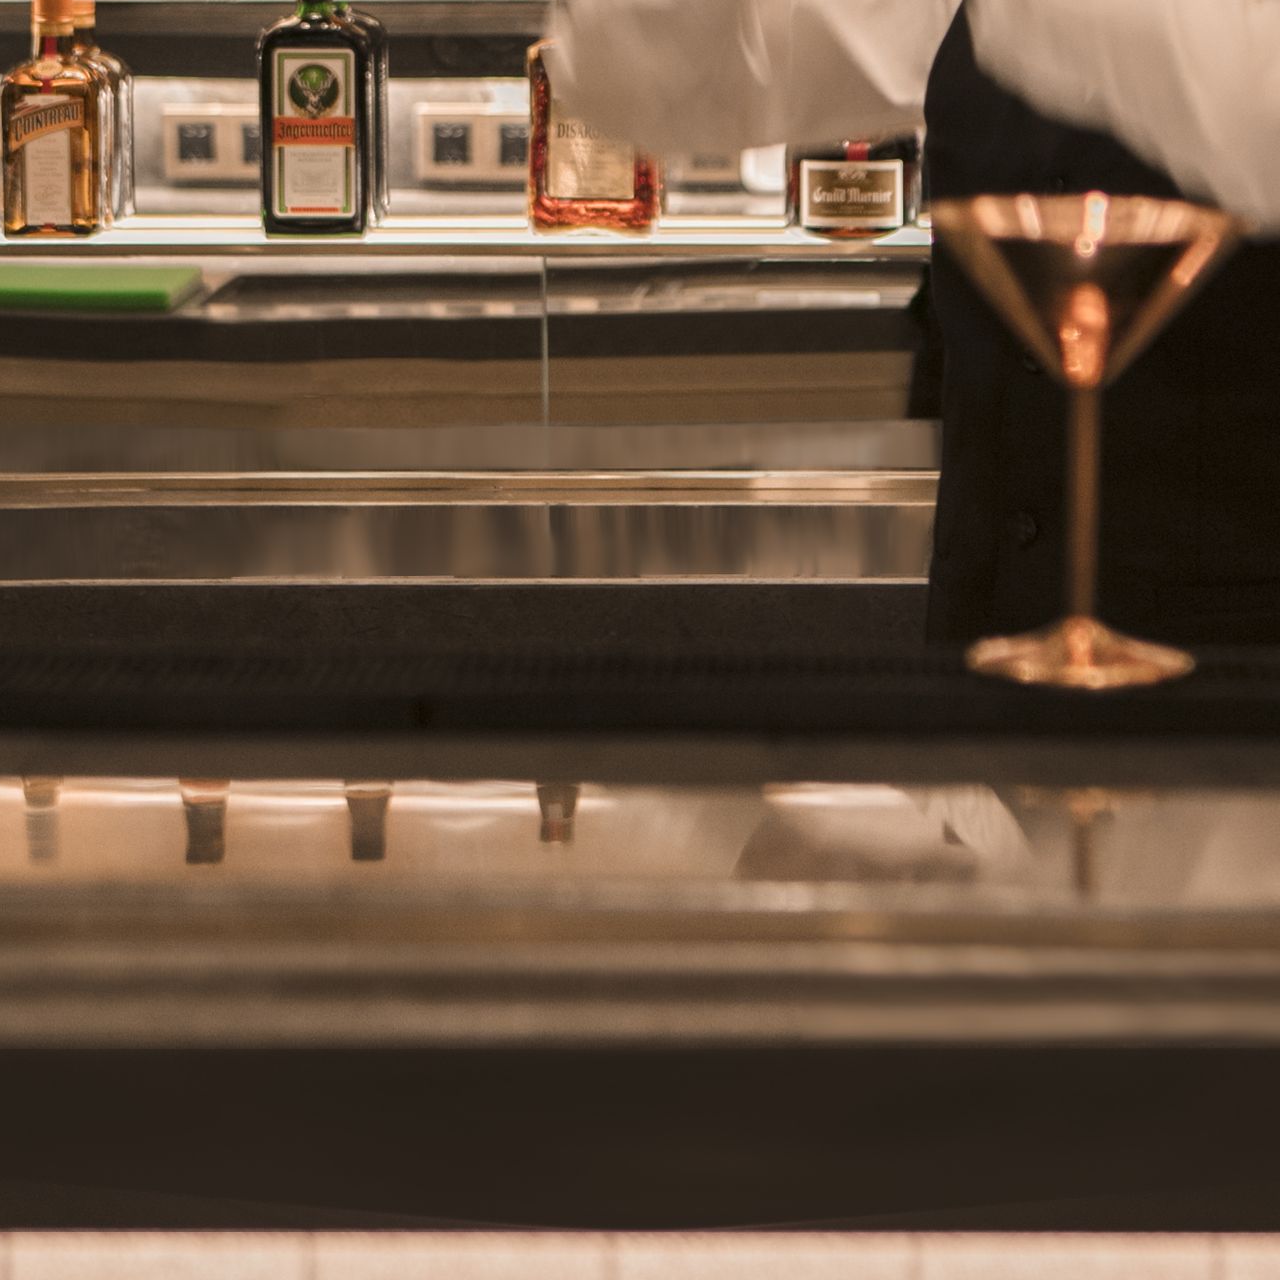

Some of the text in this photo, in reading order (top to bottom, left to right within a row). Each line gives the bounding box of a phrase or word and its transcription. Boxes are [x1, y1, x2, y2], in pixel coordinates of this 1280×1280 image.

[14, 103, 81, 142] COINTREAU
[813, 186, 892, 204] Grand Marnier
